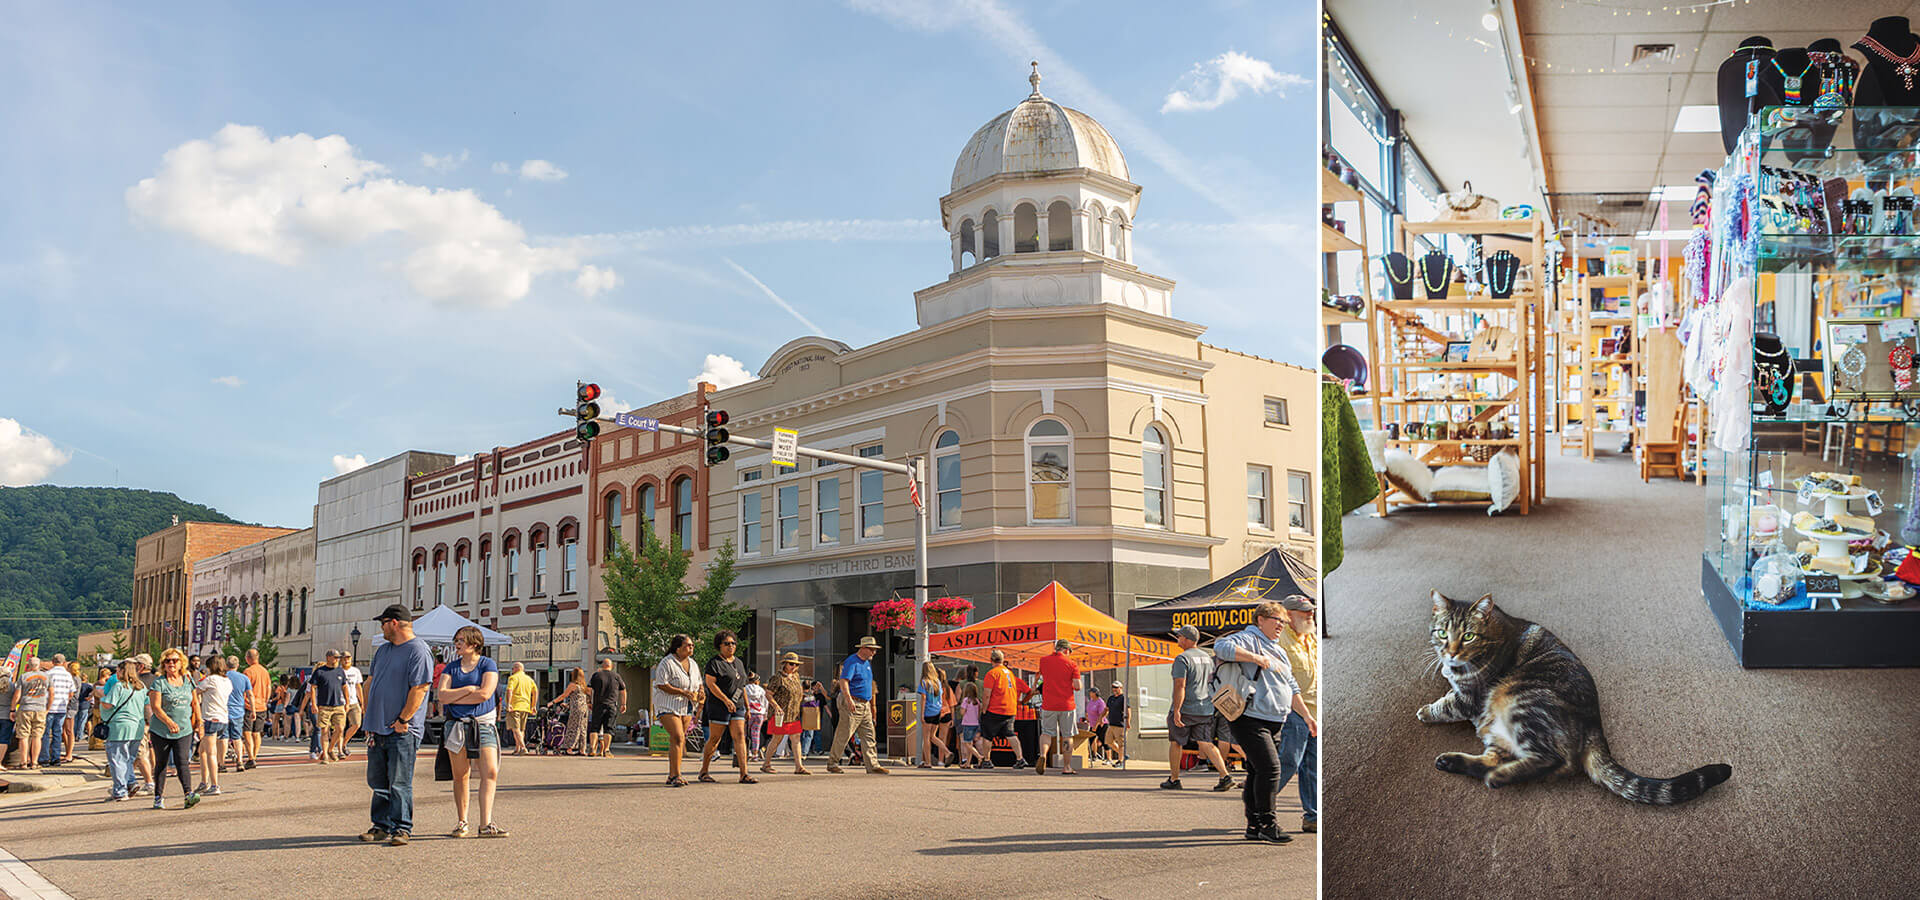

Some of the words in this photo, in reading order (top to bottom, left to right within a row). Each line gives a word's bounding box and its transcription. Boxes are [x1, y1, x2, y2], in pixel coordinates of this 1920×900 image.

[628, 416, 647, 428] Court
[808, 562, 838, 577] FIFTH
[842, 559, 880, 573] THIRD
[195, 612, 203, 641] ARTS
[215, 608, 223, 639] SHOP
[943, 626, 1039, 649] ASPLUNDH
[1073, 628, 1170, 657] ASPLUNDH
